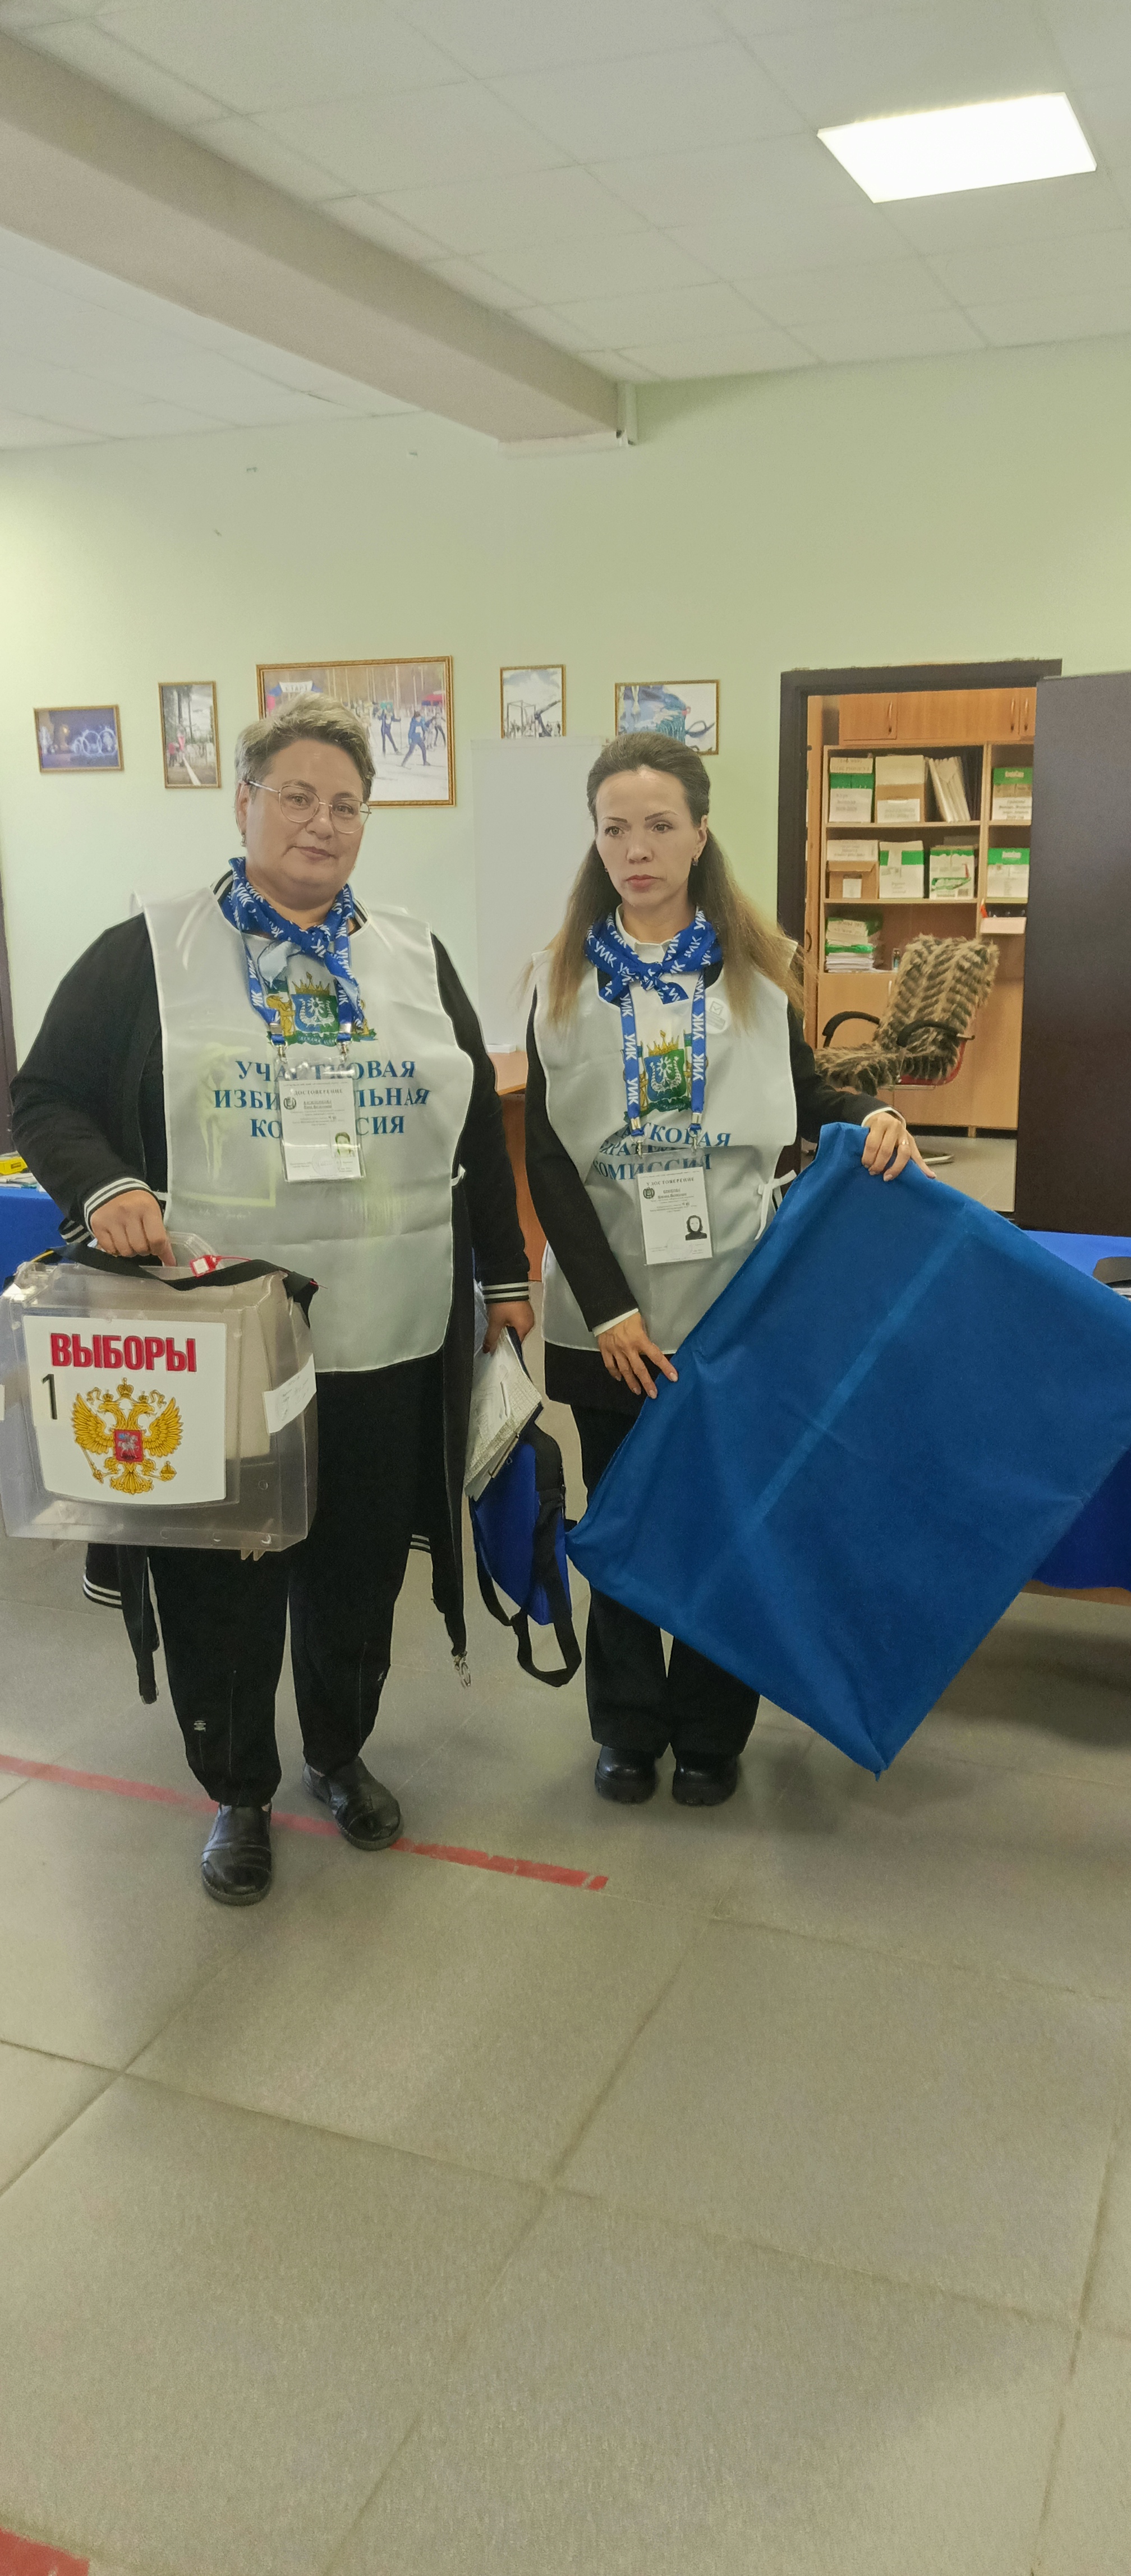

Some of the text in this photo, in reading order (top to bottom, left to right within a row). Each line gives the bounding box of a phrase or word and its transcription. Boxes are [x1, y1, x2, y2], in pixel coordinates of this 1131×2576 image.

[594, 941, 617, 968] УИК
[620, 993, 633, 1017] УИК
[692, 1012, 704, 1041] УИК
[624, 1033, 637, 1060] УИК
[235, 1060, 416, 1082] УЧАТОВАЯ
[692, 1053, 704, 1081] УИК
[213, 1087, 431, 1110] ИЗБИЬНАЯ
[627, 1077, 639, 1106] УИК
[250, 1116, 404, 1139] КОСИЯ
[50, 1333, 197, 1372] ВЫБОРЫ
[42, 1373, 57, 1420] 1
